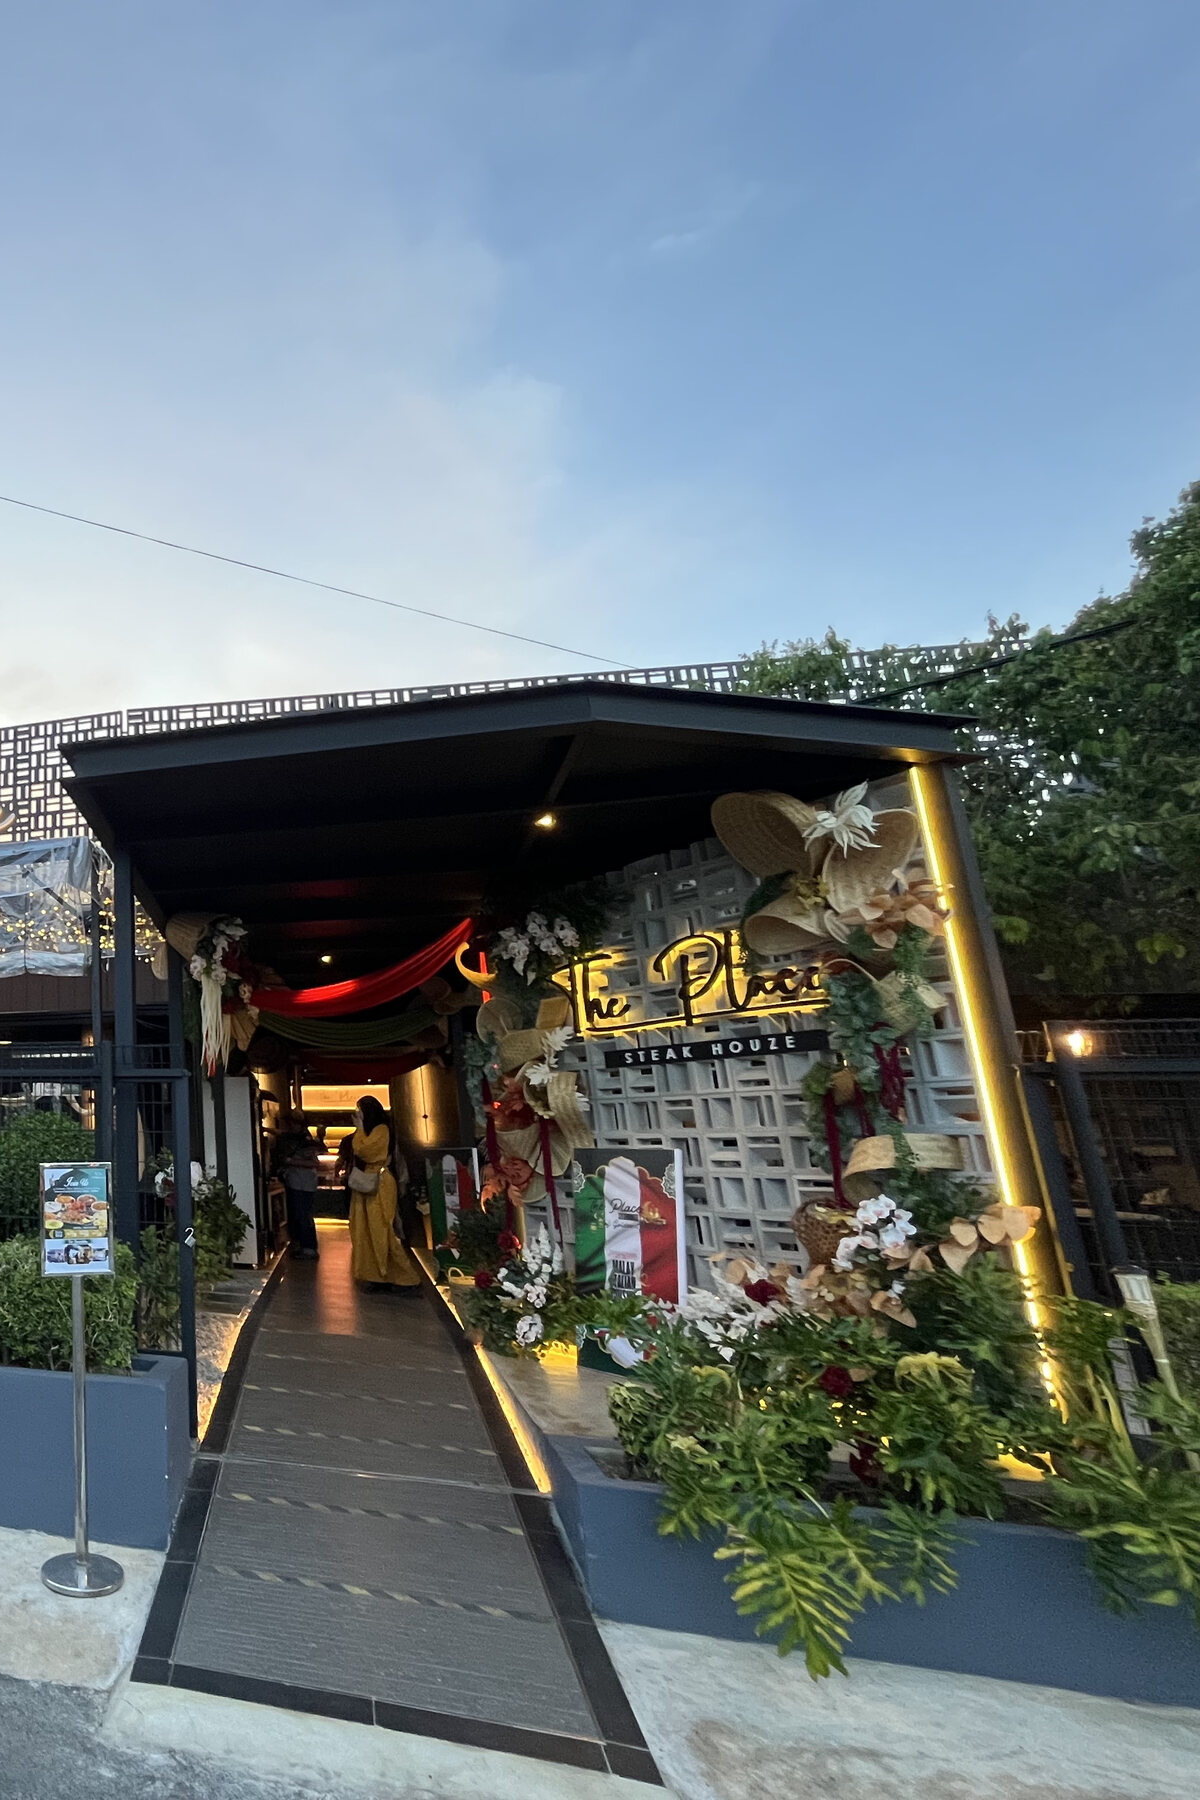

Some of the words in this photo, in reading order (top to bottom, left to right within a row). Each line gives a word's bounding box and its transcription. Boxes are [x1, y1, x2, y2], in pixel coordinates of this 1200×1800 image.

[550, 953, 631, 1033] The
[624, 1046, 693, 1064] STEAK
[711, 1035, 797, 1056] HOUZE
